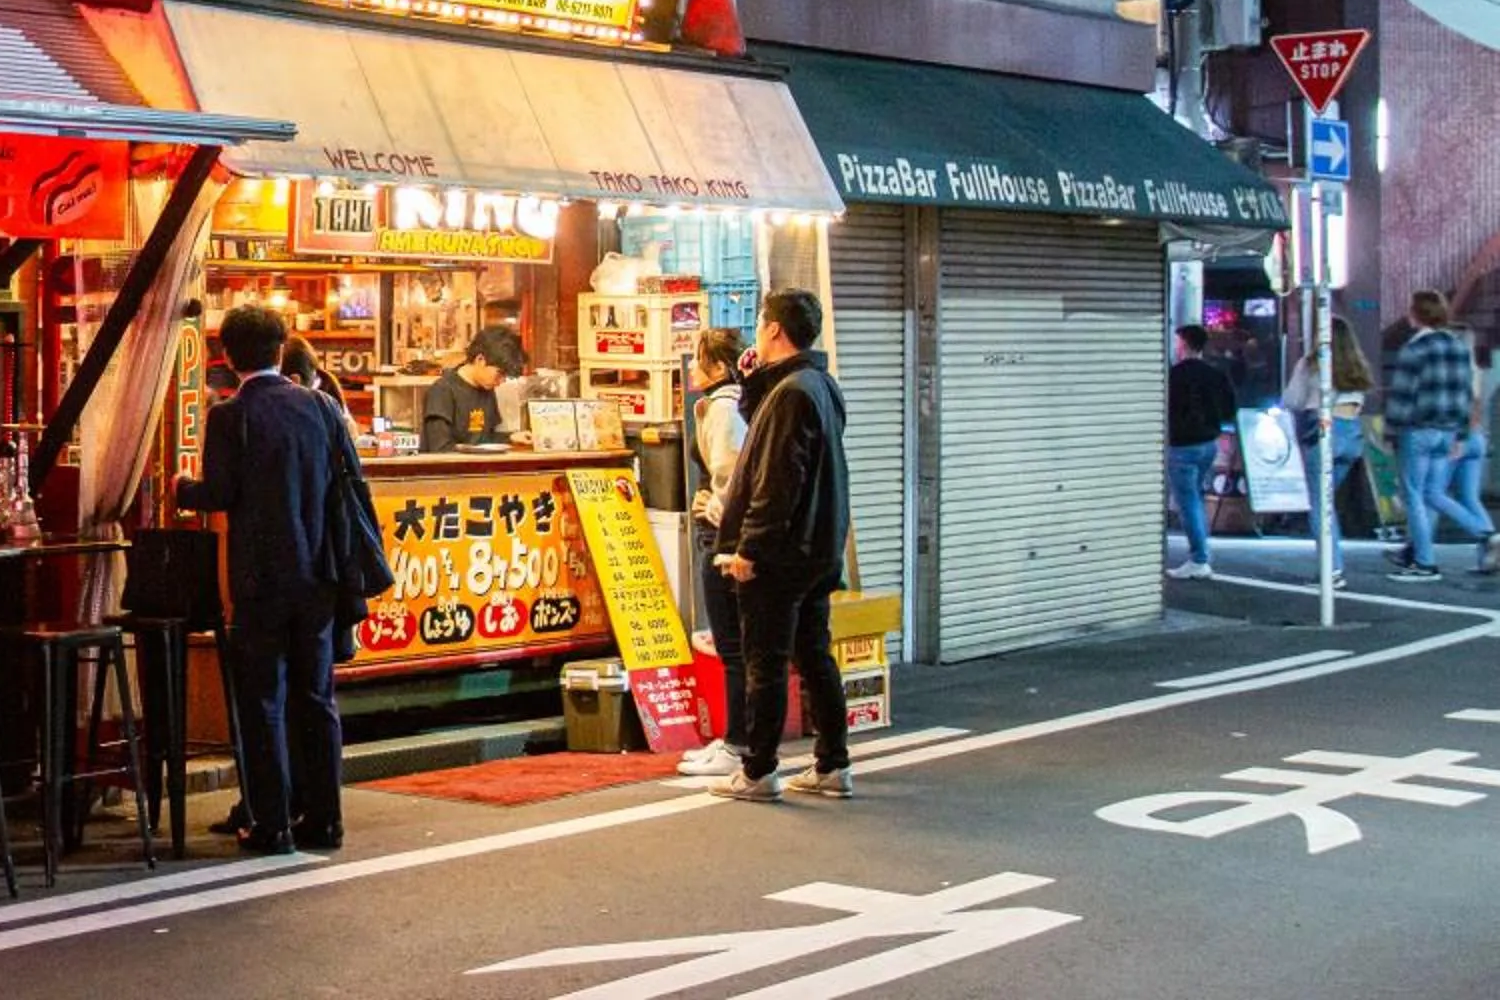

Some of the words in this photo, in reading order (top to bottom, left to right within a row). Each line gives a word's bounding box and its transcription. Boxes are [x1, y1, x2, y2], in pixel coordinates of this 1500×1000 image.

[1289, 39, 1349, 62] 止まれ
[1301, 62, 1341, 79] STOP
[323, 145, 439, 178] WELCOME
[589, 169, 643, 194] TAKO
[649, 173, 700, 198] TAKO
[705, 178, 749, 200] KING
[837, 152, 939, 199] PizzaBar
[945, 161, 1051, 206] FullHouse
[1056, 170, 1136, 212] PizzaBar
[1143, 179, 1230, 219] FullHouse
[393, 490, 557, 542] 大たこやき
[424, 609, 471, 641] しょうゆ
[484, 604, 520, 633] しお
[533, 599, 578, 630] ポンズ
[369, 617, 407, 645] ソース
